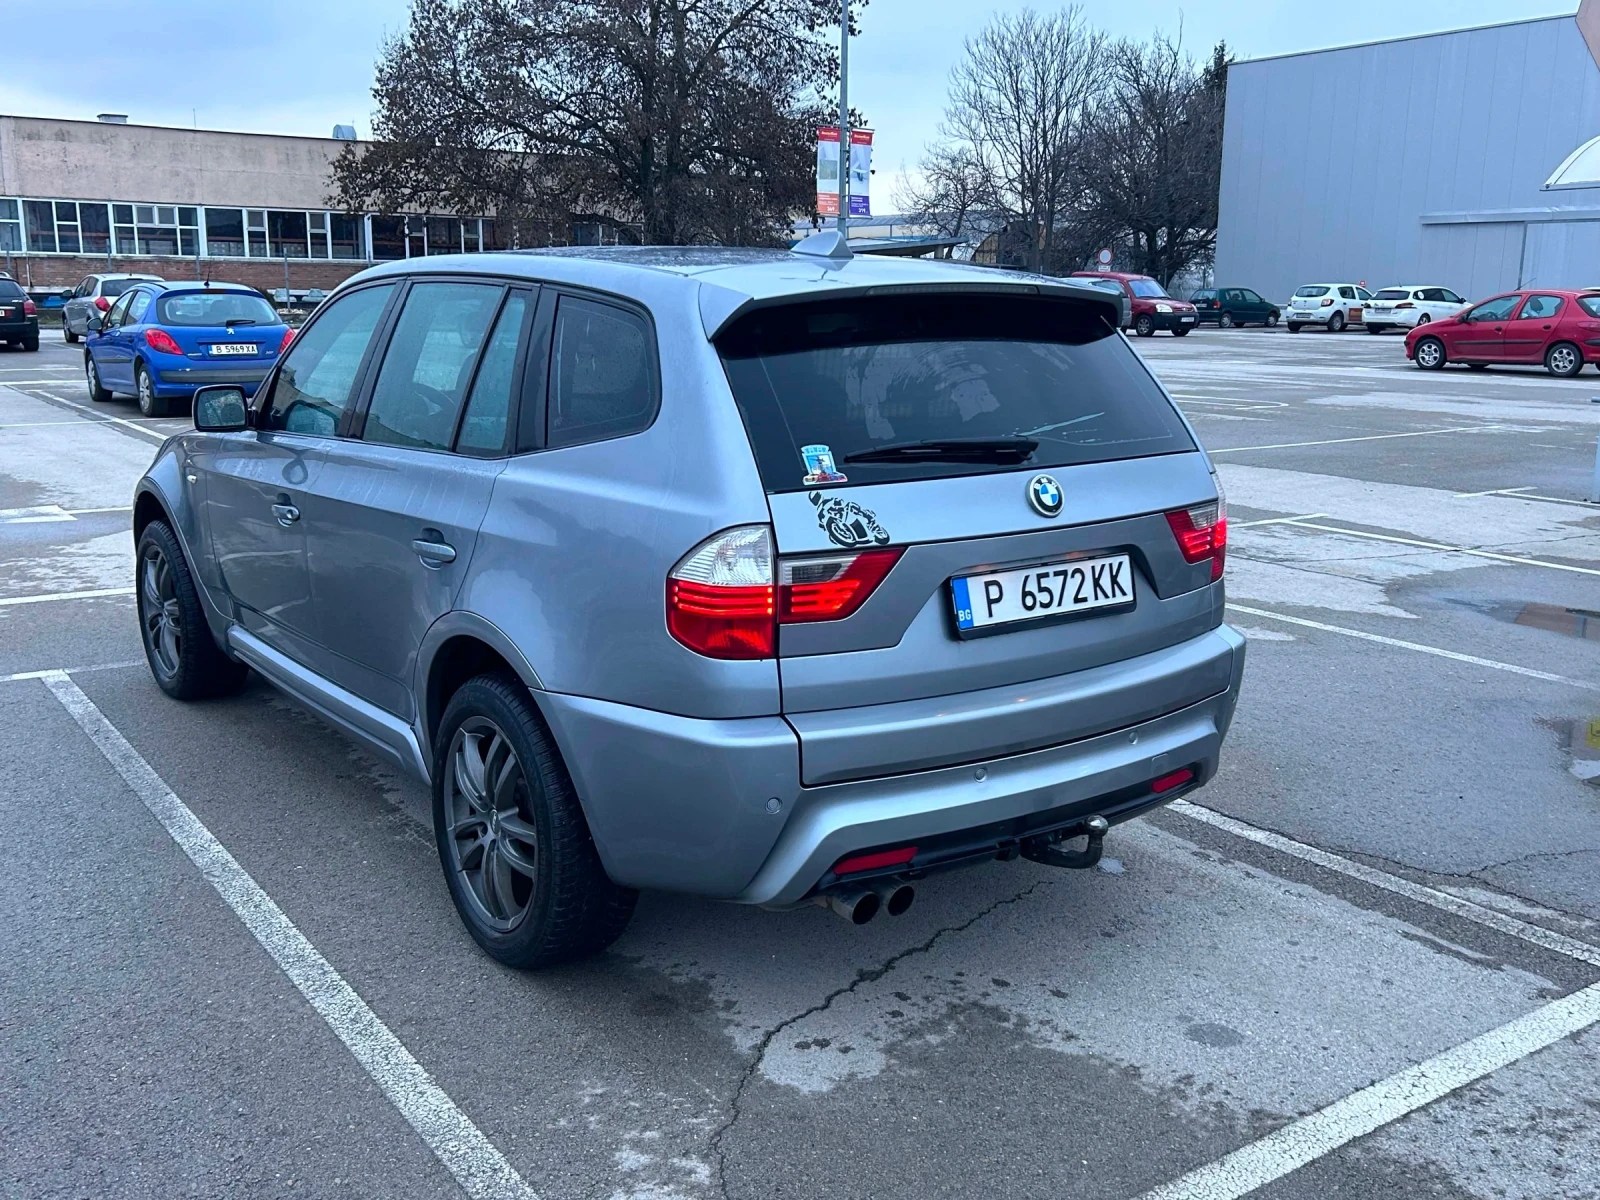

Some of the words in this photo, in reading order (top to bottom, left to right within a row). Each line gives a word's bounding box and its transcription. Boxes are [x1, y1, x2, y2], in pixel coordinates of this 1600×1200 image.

[216, 345, 222, 353] B
[984, 579, 1004, 618] P
[1021, 561, 1128, 611] 6572KK
[958, 609, 972, 622] BG
